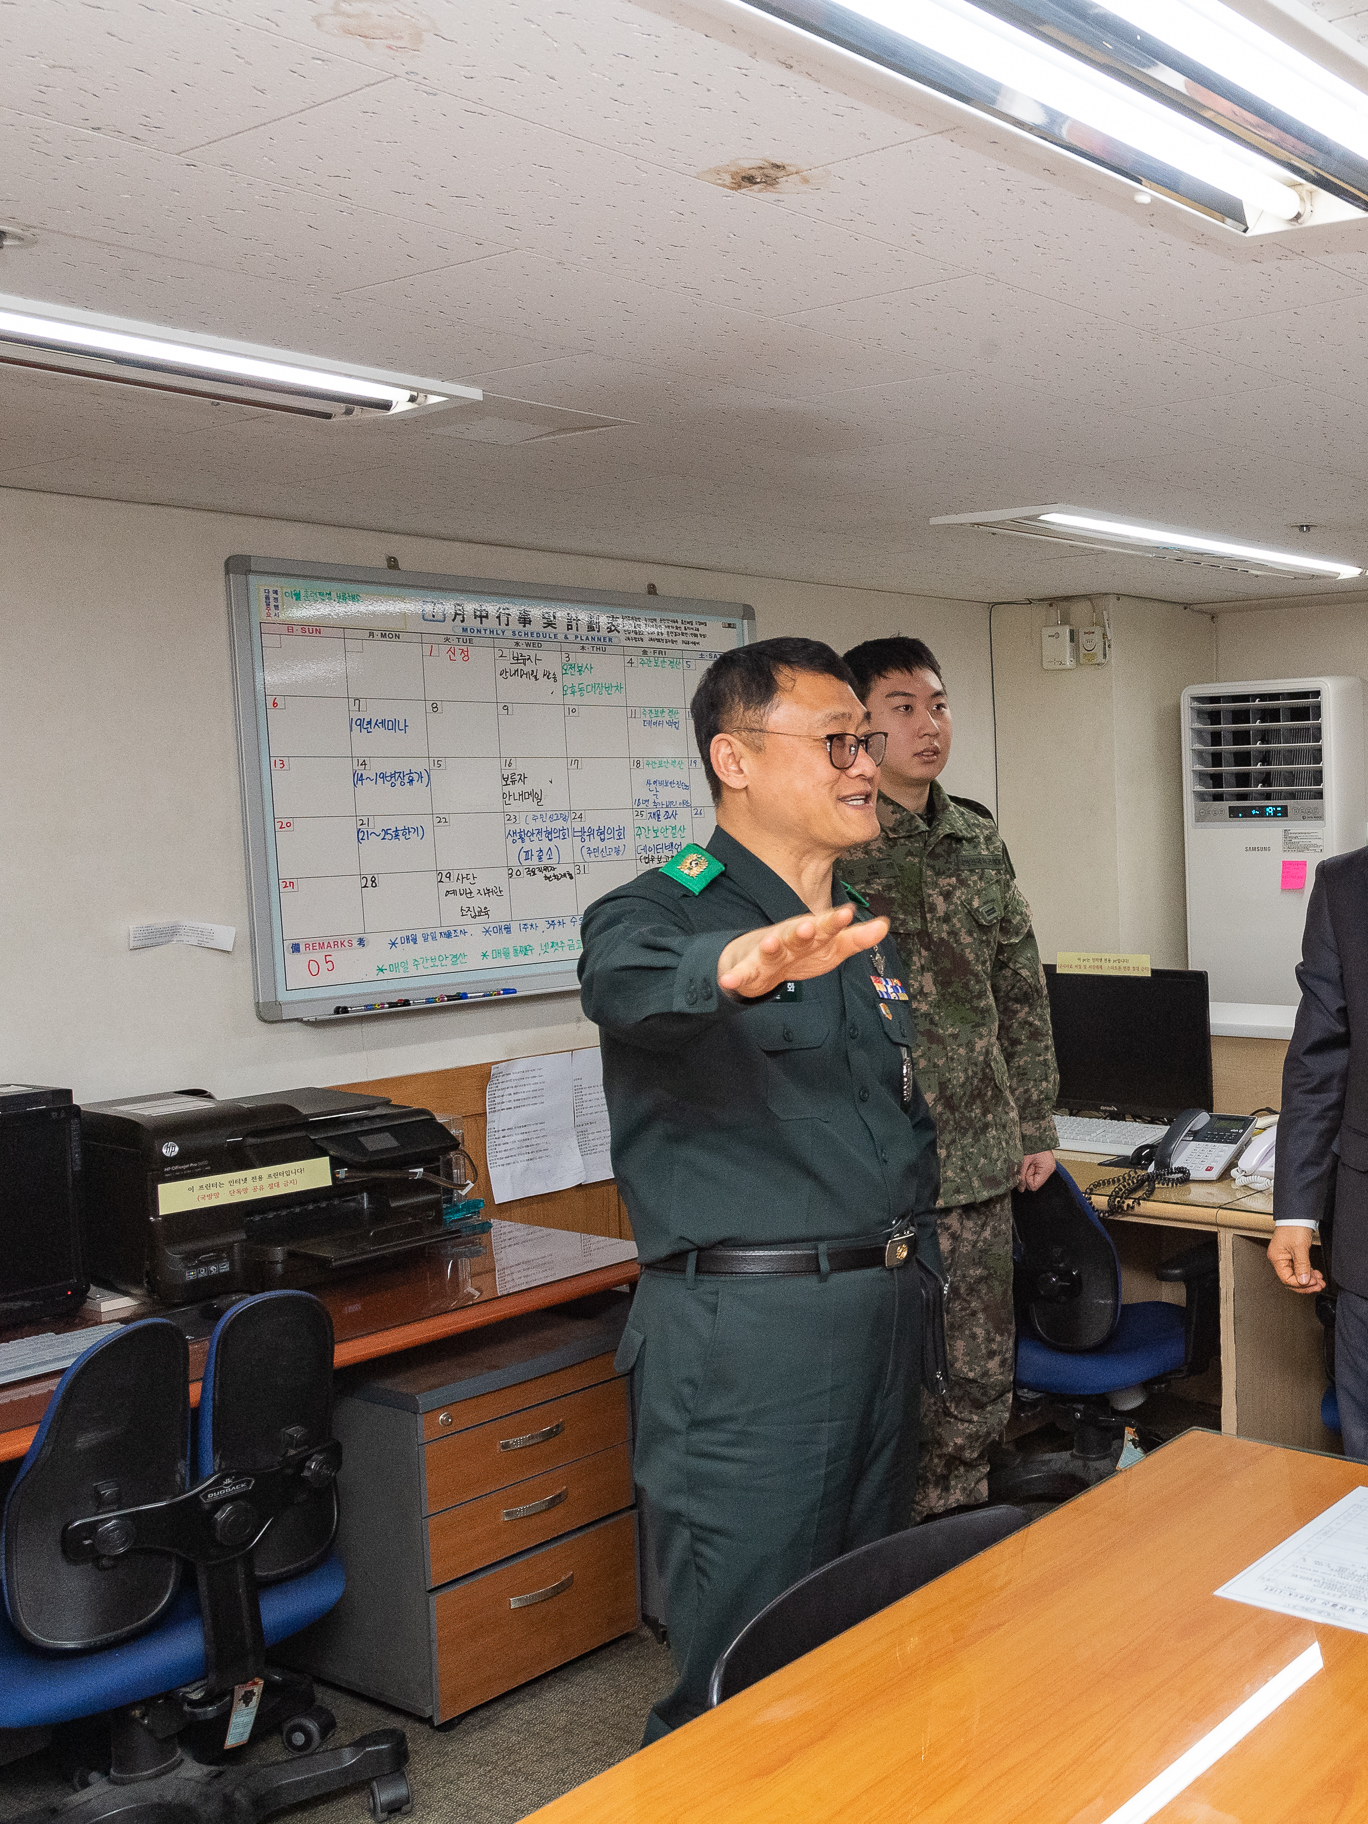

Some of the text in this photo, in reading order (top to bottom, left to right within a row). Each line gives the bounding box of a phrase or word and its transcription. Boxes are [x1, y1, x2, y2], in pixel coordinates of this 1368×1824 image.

[461, 627, 506, 636] MONTHLY
[511, 630, 559, 640] SCHEDULE
[574, 634, 614, 643] PLANNER
[429, 645, 434, 657] 1
[446, 646, 470, 662] 신정
[498, 649, 508, 659] 2
[564, 652, 571, 662] 3
[627, 657, 635, 668] 4
[685, 660, 692, 669] 5
[271, 697, 279, 708] 6
[354, 699, 361, 712] 7
[431, 702, 439, 713] 8
[502, 704, 509, 716] 9
[567, 706, 577, 715] 10
[630, 708, 637, 719] 11
[273, 759, 286, 769] 13
[356, 758, 368, 770] 14
[432, 759, 443, 768] 15
[504, 759, 514, 768] 16
[569, 759, 580, 768] 17
[632, 759, 642, 769] 18
[689, 759, 698, 768] 19
[501, 772, 528, 787] 보류자
[502, 788, 544, 806] 안내메일
[571, 812, 583, 821] 24
[634, 810, 645, 819] 25
[693, 808, 703, 816] 26
[358, 818, 370, 827] 21
[436, 816, 448, 824] 22
[505, 814, 518, 824] 23
[276, 820, 292, 830] 20
[508, 868, 522, 878] 30
[575, 865, 587, 875] 31
[361, 875, 378, 889] 28
[437, 871, 452, 883] 29
[455, 872, 478, 885] 사단
[281, 880, 295, 890] 27
[304, 938, 354, 951] REMARKS
[198, 1180, 225, 1192] 프린터는
[228, 1176, 249, 1187] 인터넷
[251, 1173, 264, 1183] 전용
[267, 1167, 305, 1181] 프린터입니다!
